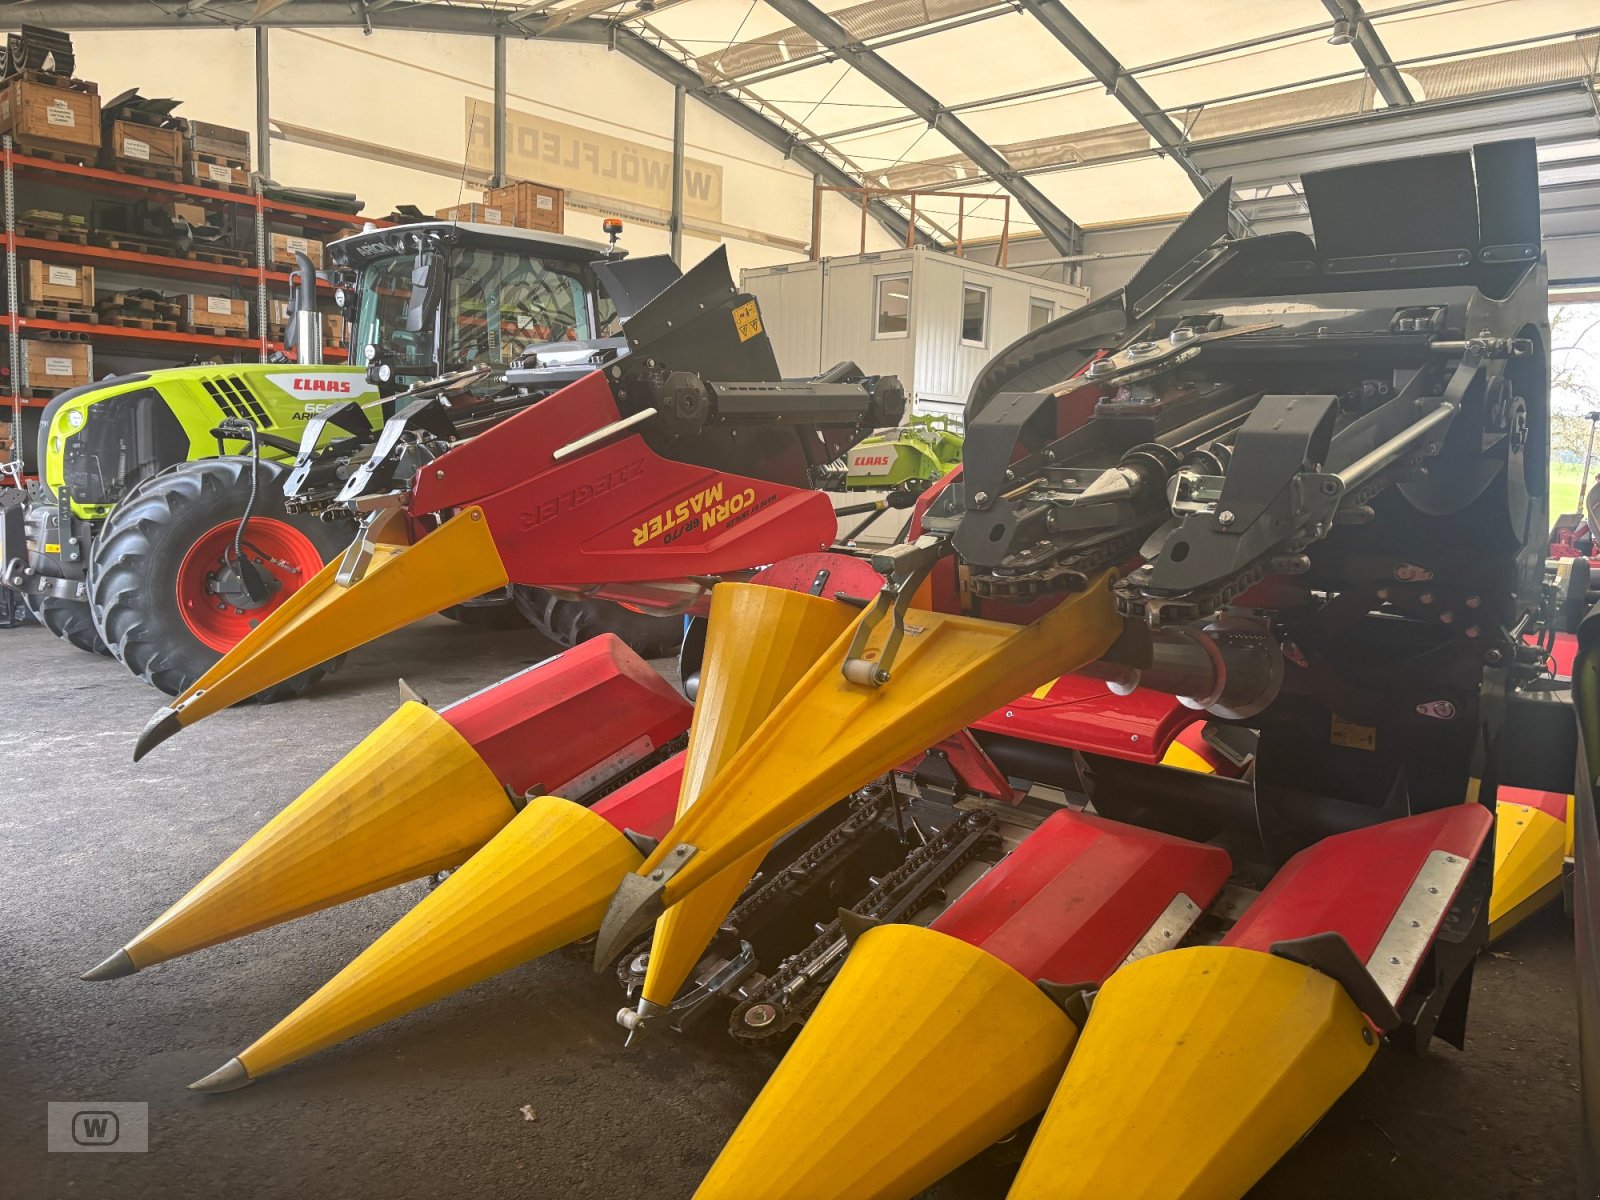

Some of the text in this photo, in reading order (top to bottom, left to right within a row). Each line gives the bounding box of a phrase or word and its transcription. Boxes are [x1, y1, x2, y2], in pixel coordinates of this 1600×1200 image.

[356, 241, 394, 257] ARION
[293, 378, 351, 393] CLAAS
[304, 403, 333, 413] 66
[854, 456, 889, 466] CLAAS
[516, 456, 646, 533] ZIEGLER
[631, 481, 723, 547] MASTER
[702, 488, 756, 532] CORN
